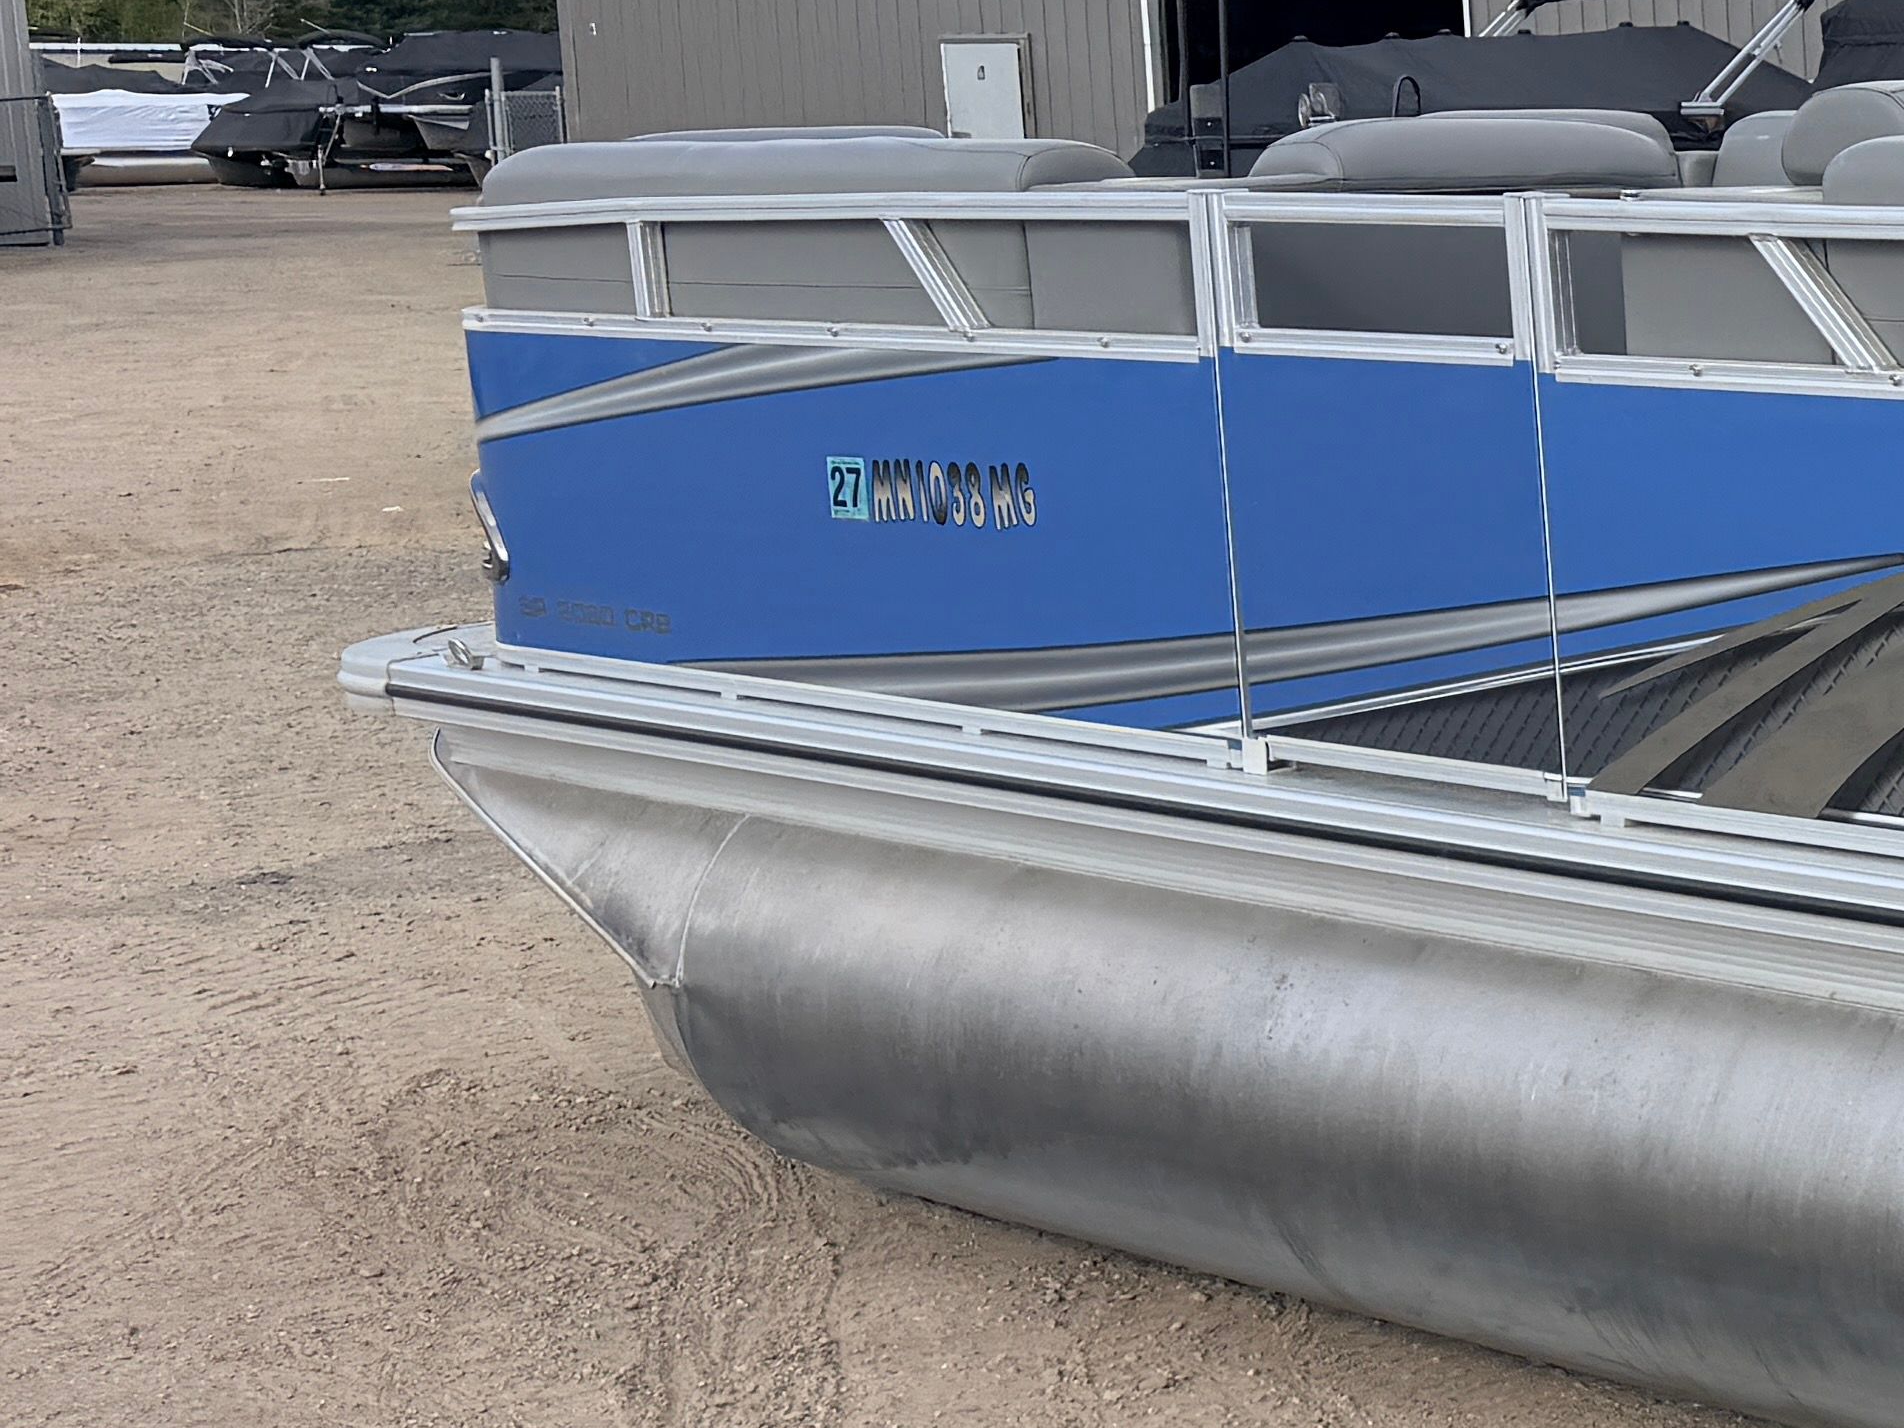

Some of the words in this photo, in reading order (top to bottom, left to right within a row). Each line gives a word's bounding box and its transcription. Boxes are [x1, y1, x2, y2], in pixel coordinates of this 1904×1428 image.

[830, 465, 861, 508] 27
[872, 459, 915, 523] MN
[916, 460, 986, 529] 1038
